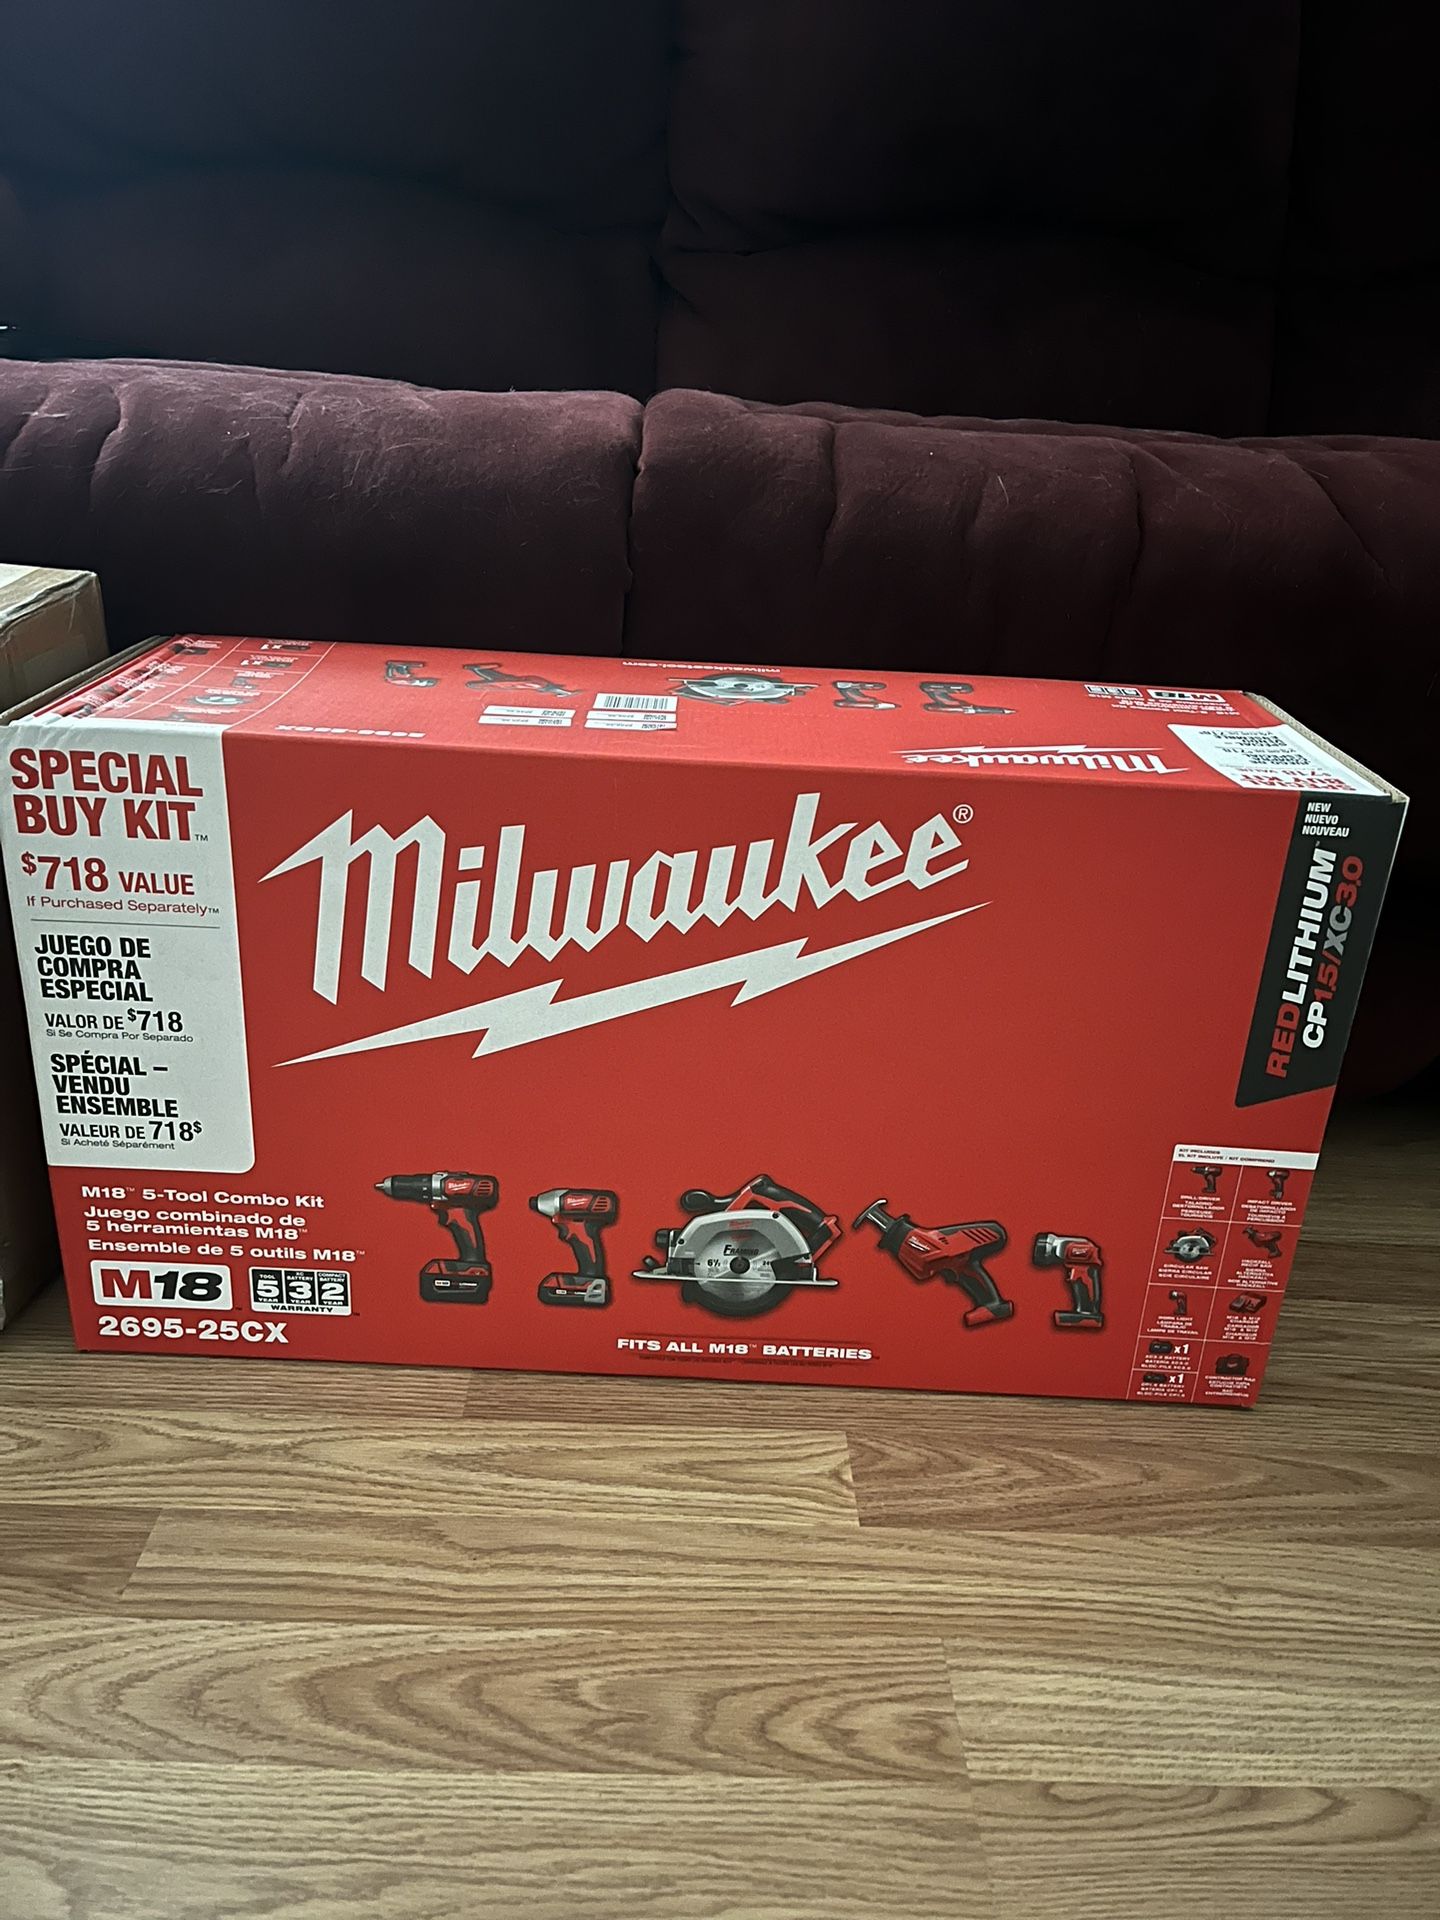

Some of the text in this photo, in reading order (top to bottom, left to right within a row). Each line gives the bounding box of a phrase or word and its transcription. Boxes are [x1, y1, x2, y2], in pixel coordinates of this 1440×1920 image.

[9, 748, 203, 797] SPECIAL
[902, 753, 1190, 774] Milwaukee
[13, 794, 107, 836] BUY
[1307, 802, 1332, 813] NEW
[1304, 813, 1340, 826] NUEVO
[1302, 825, 1351, 838] NOUVEAU
[21, 852, 195, 895] $718 VALUE
[26, 896, 36, 907] If
[41, 896, 123, 911] Purchased
[35, 934, 151, 958] JUEGO DE
[37, 956, 142, 980] COMPRA
[40, 979, 154, 1002] ESPECIAL
[45, 1008, 183, 1033] VALOR DE $718
[46, 1029, 194, 1043] Si Se Compra Por Separado
[50, 1050, 147, 1076] SPÉCIAL
[52, 1074, 130, 1096] VENDU
[55, 1095, 179, 1118] ENSEMBLE
[60, 1120, 202, 1142] VALEUR DE 718$
[61, 1138, 71, 1146] Si
[73, 1138, 110, 1147] Acheté
[142, 1188, 208, 1203] 5-Tool
[214, 1191, 289, 1207] Combo
[295, 1194, 325, 1209] Kit
[84, 1206, 305, 1227] Juego combinado de
[86, 1220, 101, 1232] 5
[106, 1220, 250, 1239] herramientas
[88, 1239, 191, 1255] Ensemble
[197, 1243, 223, 1256] de
[230, 1245, 244, 1257] 5
[250, 1246, 307, 1261] outils
[99, 1268, 224, 1303] M18
[256, 1279, 280, 1298] 5
[288, 1281, 313, 1300] 3
[321, 1282, 345, 1301] 2
[270, 1304, 334, 1313] WARRANTY
[98, 1316, 289, 1344] 2695-25CX
[617, 1338, 661, 1351] FITS
[666, 1341, 703, 1353] ALL
[763, 1345, 872, 1360] BATTERIES
[1174, 1344, 1189, 1354] x1
[1169, 1373, 1184, 1384] x1
